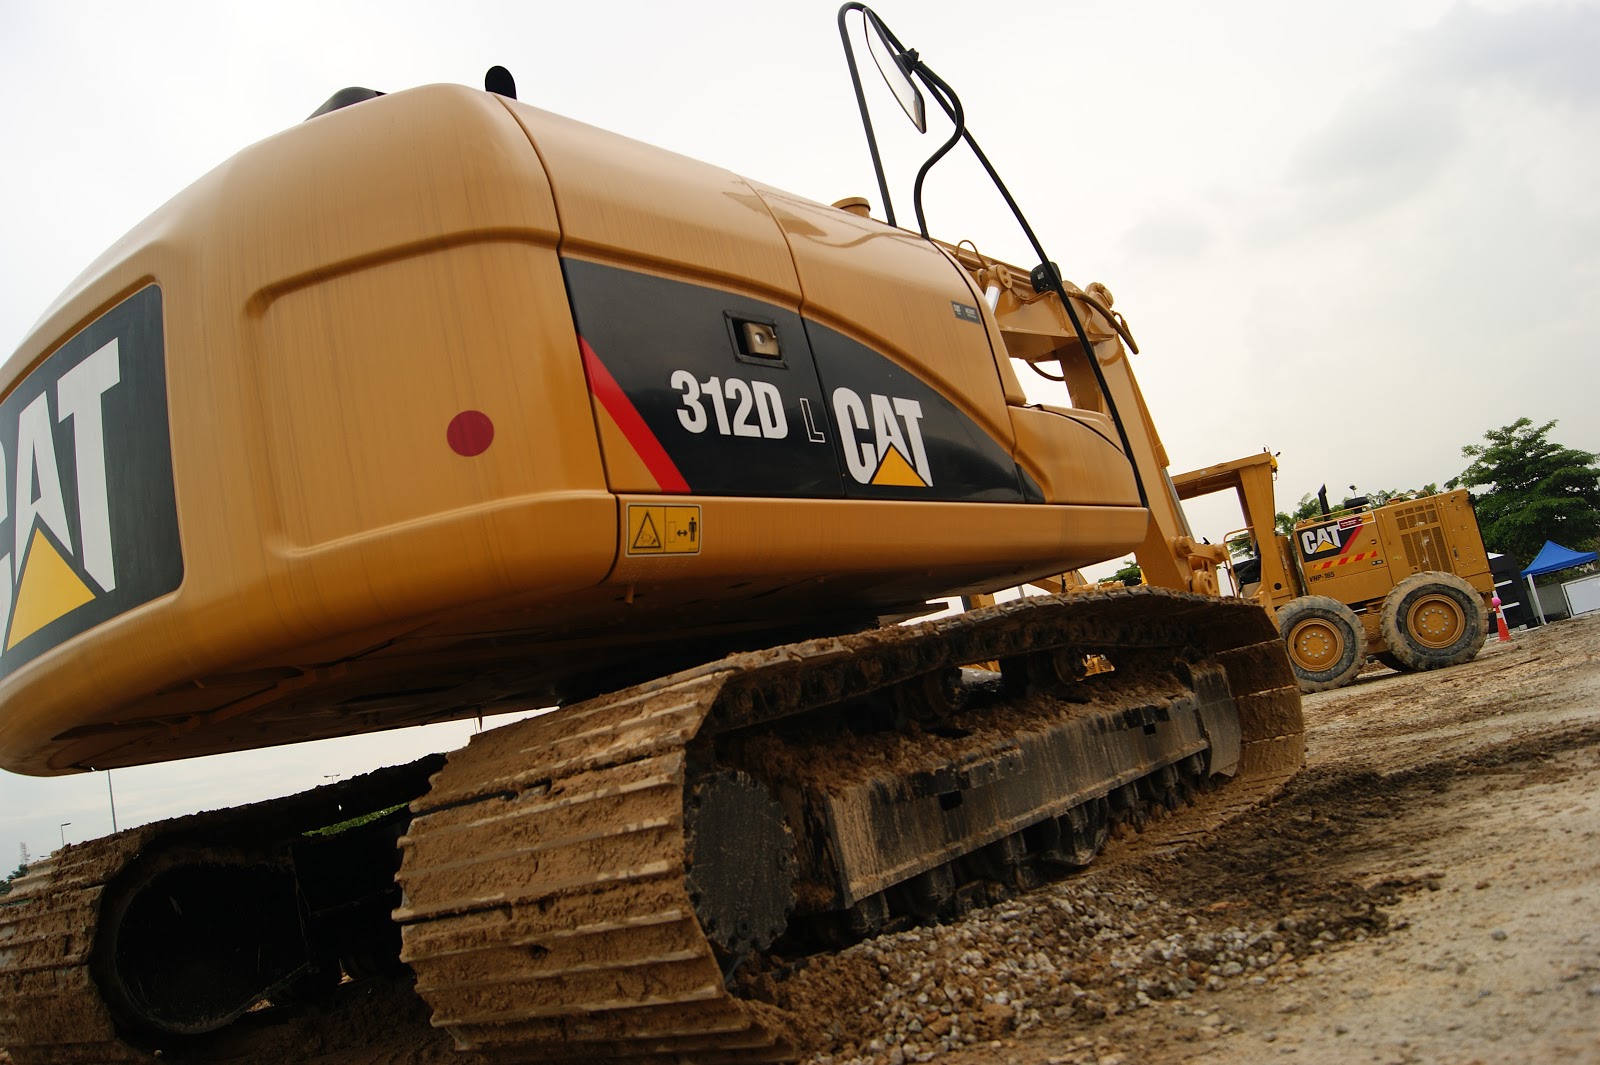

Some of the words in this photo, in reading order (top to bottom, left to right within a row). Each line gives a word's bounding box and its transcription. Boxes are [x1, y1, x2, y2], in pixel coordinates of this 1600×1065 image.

[670, 369, 788, 440] 312D
[800, 397, 826, 443] L
[832, 386, 934, 487] CAT
[0, 337, 120, 657] AT
[1301, 524, 1342, 555] CAT
